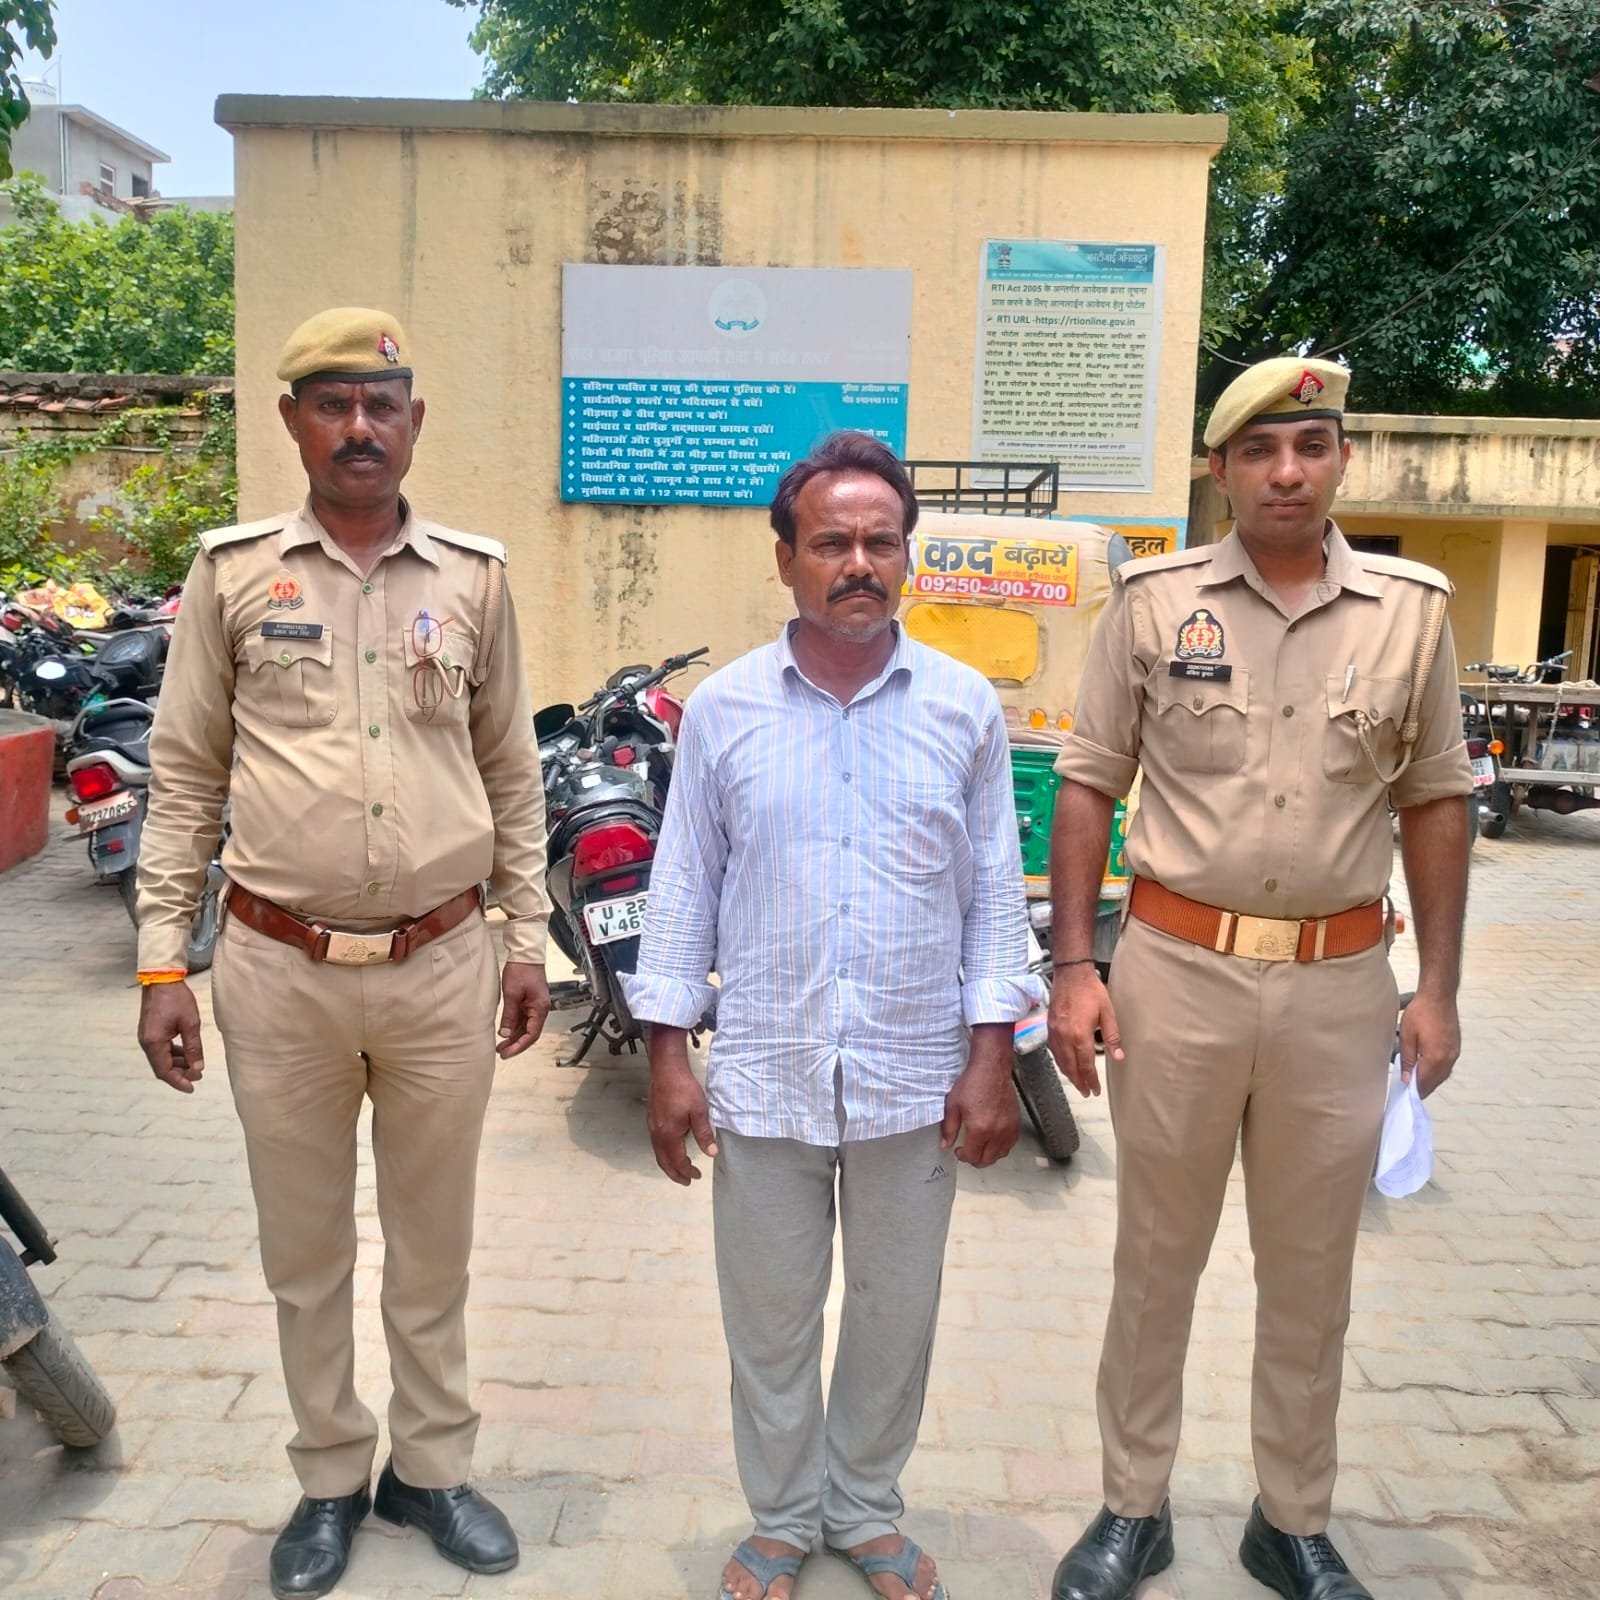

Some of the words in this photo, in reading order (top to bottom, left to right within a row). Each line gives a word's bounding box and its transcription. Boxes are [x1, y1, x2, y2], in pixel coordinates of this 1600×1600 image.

[992, 284, 1004, 292] RTI
[1023, 284, 1042, 292] 2005
[1044, 282, 1050, 292] के
[1025, 298, 1032, 306] के
[996, 315, 1011, 323] RTI
[1013, 315, 1031, 324] URL
[582, 381, 614, 392] संदिग्ध
[616, 382, 646, 392] व्यक्ति
[650, 384, 658, 392] व
[661, 384, 681, 394] वस्तु
[684, 383, 698, 393] की
[702, 384, 730, 396] सूचना
[734, 384, 762, 396] पुलिस
[766, 384, 780, 394] को
[582, 394, 632, 405] सार्वजनिक
[636, 395, 663, 406] स्थलों
[666, 398, 678, 406] पर
[682, 396, 727, 407] मदिरापान
[730, 397, 740, 407] से
[622, 408, 633, 418] के
[636, 408, 655, 418] बीच
[696, 410, 705, 420] न
[582, 421, 620, 432] भाईचारा
[624, 424, 632, 432] व
[636, 422, 668, 432] धार्मिक
[720, 424, 750, 434] कायम
[582, 434, 628, 444] महिलाओं
[630, 435, 650, 445] और
[686, 437, 700, 446] का
[703, 438, 736, 447] सम्मान
[582, 446, 608, 457] किसी
[611, 446, 624, 458] भी
[627, 447, 655, 458] स्थिति
[658, 448, 668, 458] में
[689, 448, 708, 460] भीड़
[711, 450, 725, 460] का
[728, 450, 756, 460] हिस्सा
[759, 452, 768, 460] न
[582, 460, 632, 470] सार्वजनिक
[672, 462, 688, 472] को
[690, 464, 728, 474] नुकसान
[730, 464, 740, 472] न
[582, 472, 614, 484] विवादों
[616, 474, 627, 483] से
[653, 476, 682, 486] कानून
[686, 475, 700, 485] को
[703, 476, 722, 486] हाथ
[725, 476, 736, 486] में
[738, 478, 747, 486] न
[580, 486, 617, 498] मुसीबत
[619, 486, 631, 496] हो
[634, 486, 646, 496] तो
[651, 489, 670, 497] 112
[674, 490, 700, 498] नम्बर
[702, 490, 730, 498] डायल
[1123, 536, 1168, 558] हल
[924, 536, 998, 575] कद
[1003, 545, 1074, 571] बढ़ायें
[920, 576, 1068, 600] 09250-400-700
[602, 906, 614, 920] U
[599, 922, 609, 936] V
[618, 914, 644, 932] 46
